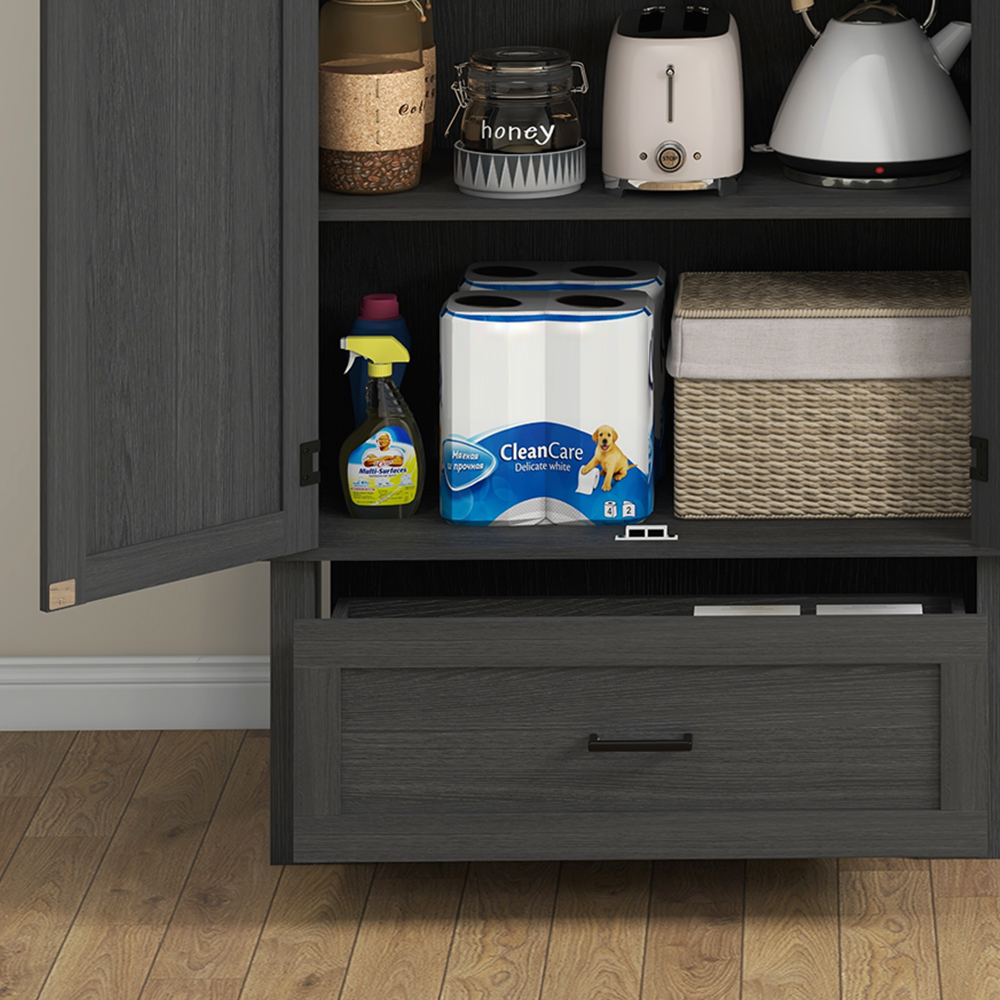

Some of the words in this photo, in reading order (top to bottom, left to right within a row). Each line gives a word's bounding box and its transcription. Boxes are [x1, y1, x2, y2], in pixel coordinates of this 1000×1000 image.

[482, 120, 555, 146] honey
[500, 442, 584, 462] CleanCare
[454, 463, 484, 473] прочная
[515, 462, 547, 473] Delicate
[549, 462, 571, 472] white
